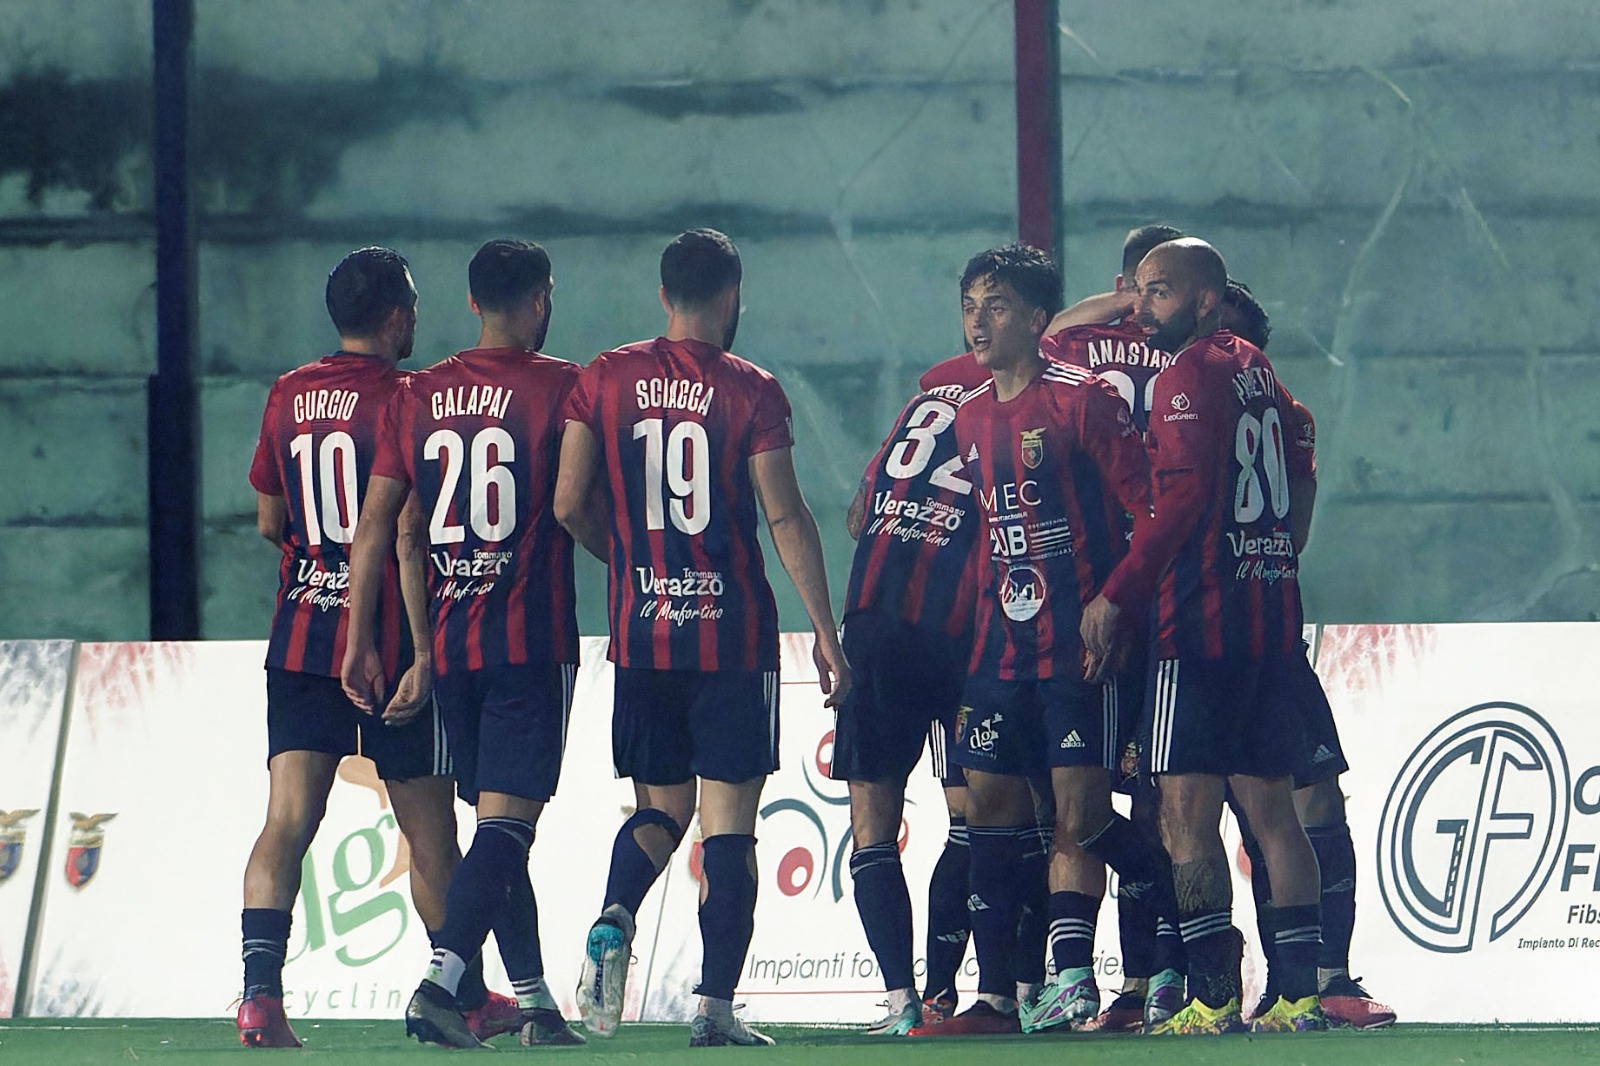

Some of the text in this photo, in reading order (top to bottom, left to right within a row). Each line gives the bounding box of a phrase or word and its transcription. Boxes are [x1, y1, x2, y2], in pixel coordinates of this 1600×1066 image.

[293, 389, 359, 424] CURCIO
[431, 385, 513, 421] CALAPAI
[635, 378, 714, 417] SCIACCA
[633, 418, 711, 535] 19
[1234, 407, 1290, 524] 80
[289, 431, 359, 546] 10
[423, 427, 517, 545] 26
[874, 490, 961, 531] Verazzo
[926, 497, 965, 517] Tommaso
[1225, 530, 1293, 558] Verazzo
[297, 559, 350, 591] Veraz
[636, 566, 724, 597] Verazzo
[654, 600, 724, 628] Monfortino
[1517, 936, 1566, 951] Impianto
[1567, 936, 1580, 949] Di
[748, 951, 847, 986] Impianti
